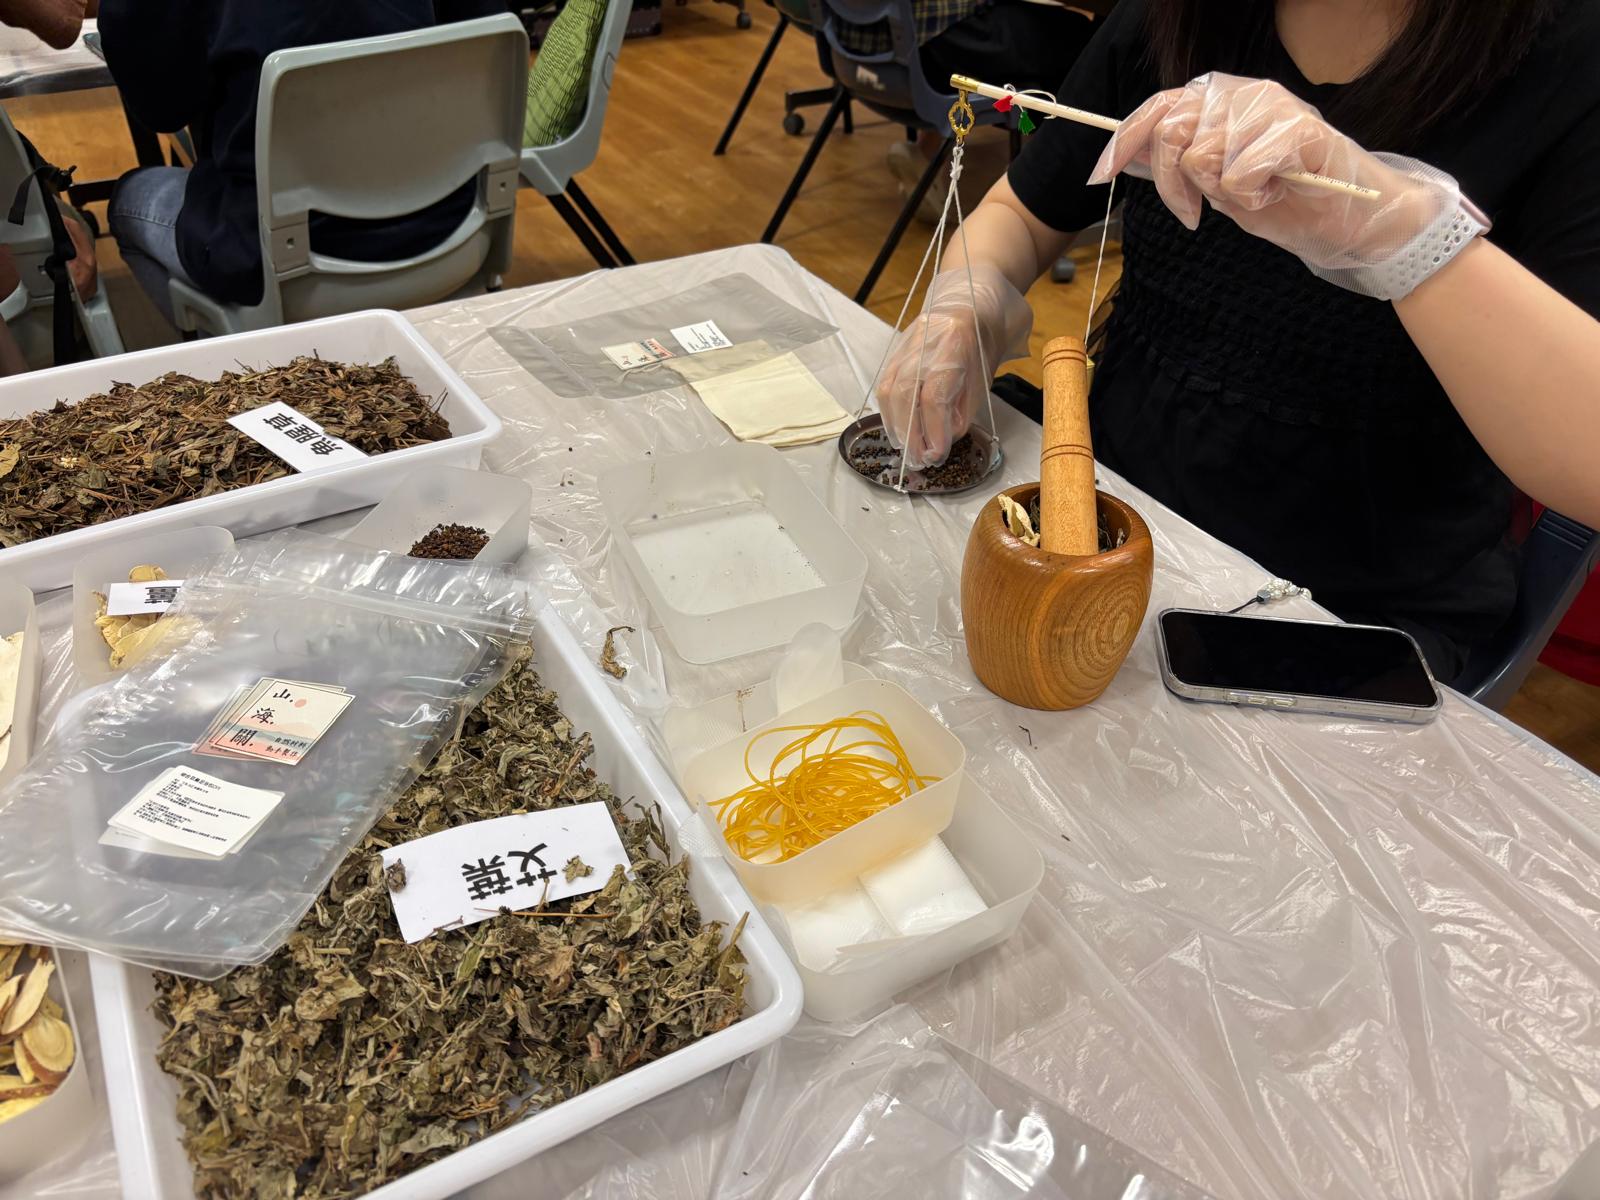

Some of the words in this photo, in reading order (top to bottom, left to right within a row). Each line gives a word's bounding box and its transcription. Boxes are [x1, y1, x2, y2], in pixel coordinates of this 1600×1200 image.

[263, 412, 343, 456] 魚腥草
[461, 843, 557, 901] 艾葉
